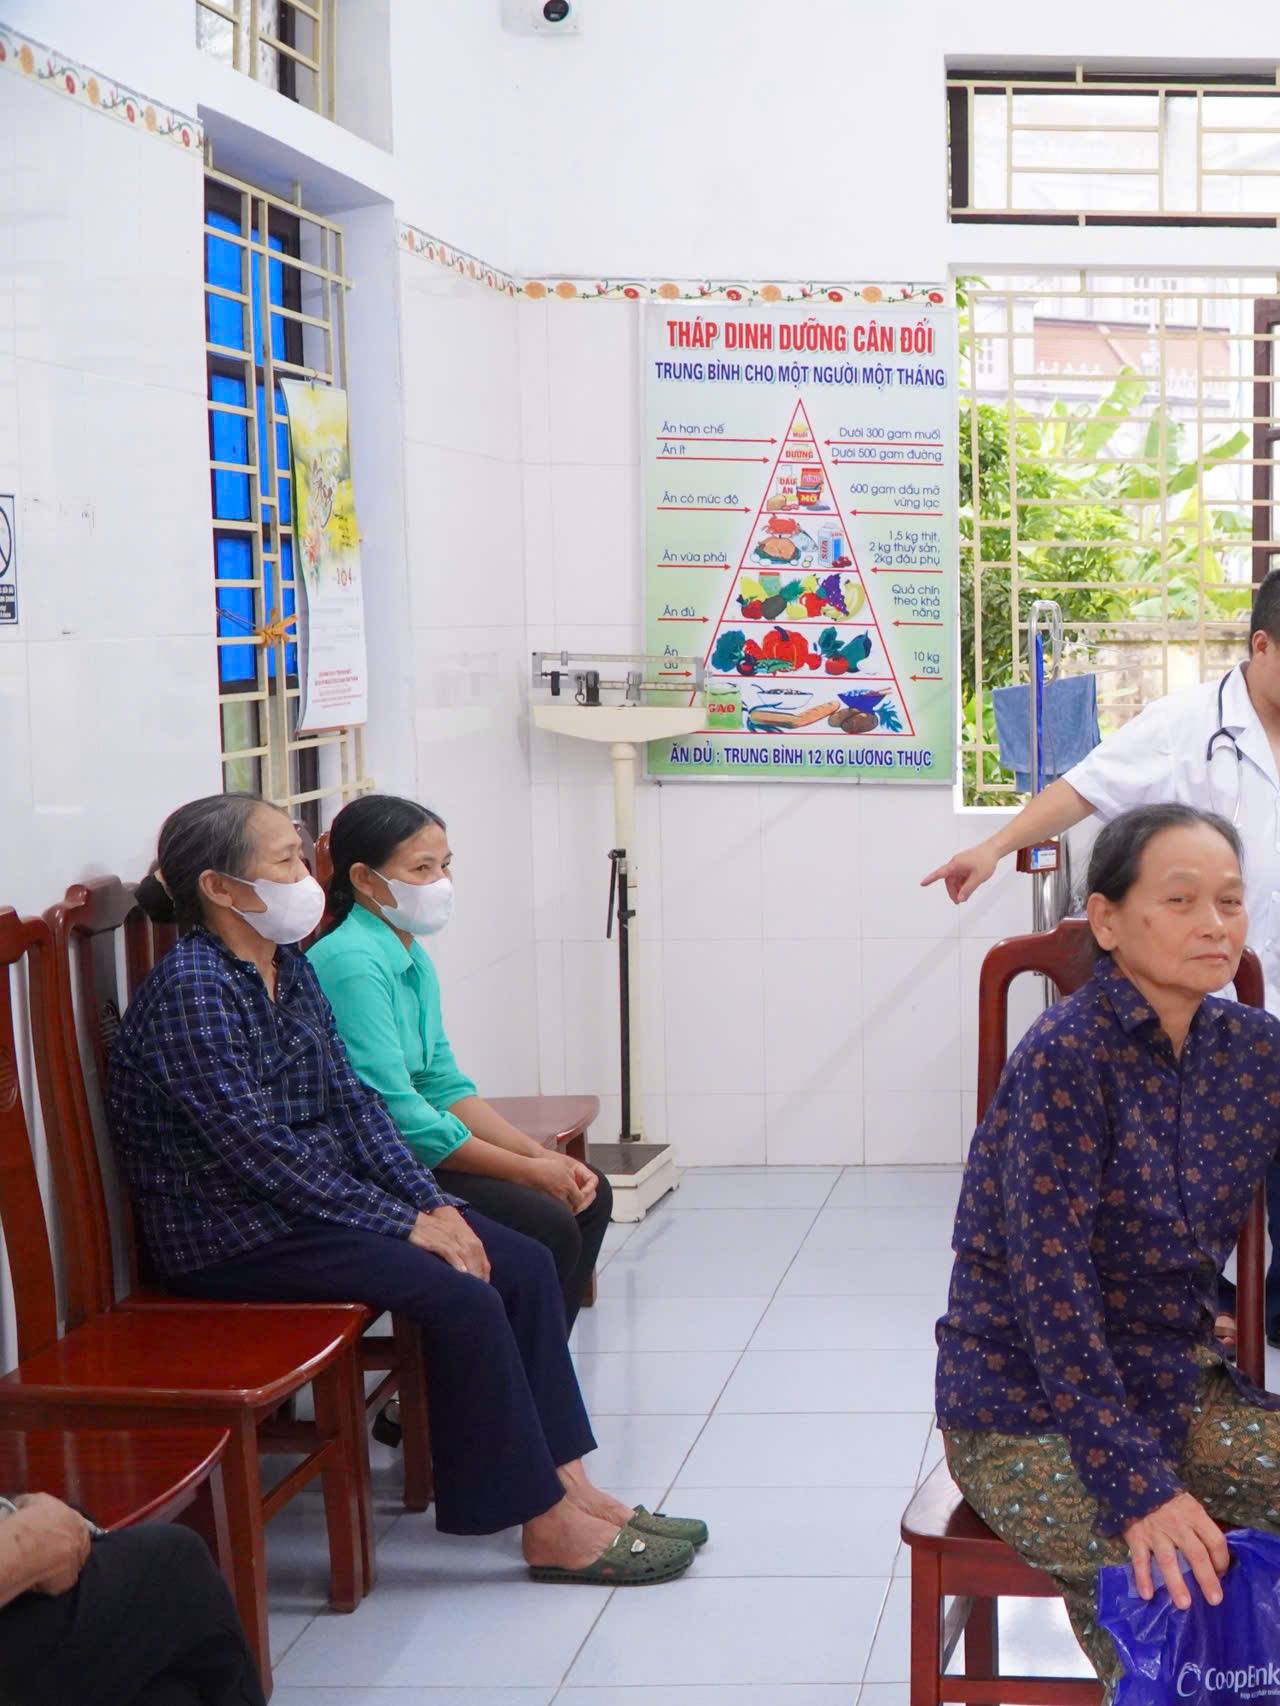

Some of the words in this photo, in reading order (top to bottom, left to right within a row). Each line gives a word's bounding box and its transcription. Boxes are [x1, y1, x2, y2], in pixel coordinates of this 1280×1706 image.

[667, 316, 718, 348] THÁP
[725, 322, 772, 350] DINH
[779, 317, 846, 352] DƯỠNG
[853, 320, 894, 353] CÂN
[900, 317, 933, 354] ĐỐI
[655, 362, 703, 380] TRUNG
[708, 359, 740, 381] BÌNH
[745, 364, 774, 382] CHO
[778, 361, 809, 388] MỘT
[813, 362, 858, 384] NGƯỜI
[862, 363, 892, 390] MỘT
[897, 364, 945, 386] THÁNG
[662, 421, 677, 433] Ăn
[703, 423, 725, 434] chế
[839, 427, 864, 438] Dưới
[866, 428, 884, 438] 300
[887, 430, 912, 440] gam
[914, 429, 941, 440] muối
[662, 443, 677, 454] Ăn
[832, 447, 856, 458] Dưới
[858, 448, 877, 458] 500
[879, 450, 904, 460] gam
[906, 448, 942, 462] đường
[850, 483, 869, 494] 600
[871, 486, 896, 496] gam
[662, 491, 677, 503] Ăn
[680, 493, 695, 504] có
[697, 493, 721, 504] mức
[905, 531, 918, 543] kg
[869, 542, 876, 551] 2
[878, 542, 891, 553] kg
[662, 549, 677, 561] Ăn
[680, 552, 701, 561] vừa
[703, 552, 727, 563] phải
[874, 553, 893, 565] 2kg
[891, 584, 915, 595] Quả
[894, 596, 918, 606] theo
[921, 596, 940, 606] khả
[663, 604, 678, 616] Ăn
[912, 608, 940, 619] năng
[664, 645, 678, 657] Ăn
[914, 651, 925, 661] 10
[927, 651, 940, 664] kg
[922, 666, 940, 674] rau
[670, 742, 689, 763] ĂN
[724, 748, 768, 764] TRUNG
[773, 744, 803, 764] BÌNH
[808, 750, 821, 764] 12
[826, 749, 844, 765] KG
[848, 748, 893, 766] LƯƠNG
[897, 749, 932, 771] THỰC
